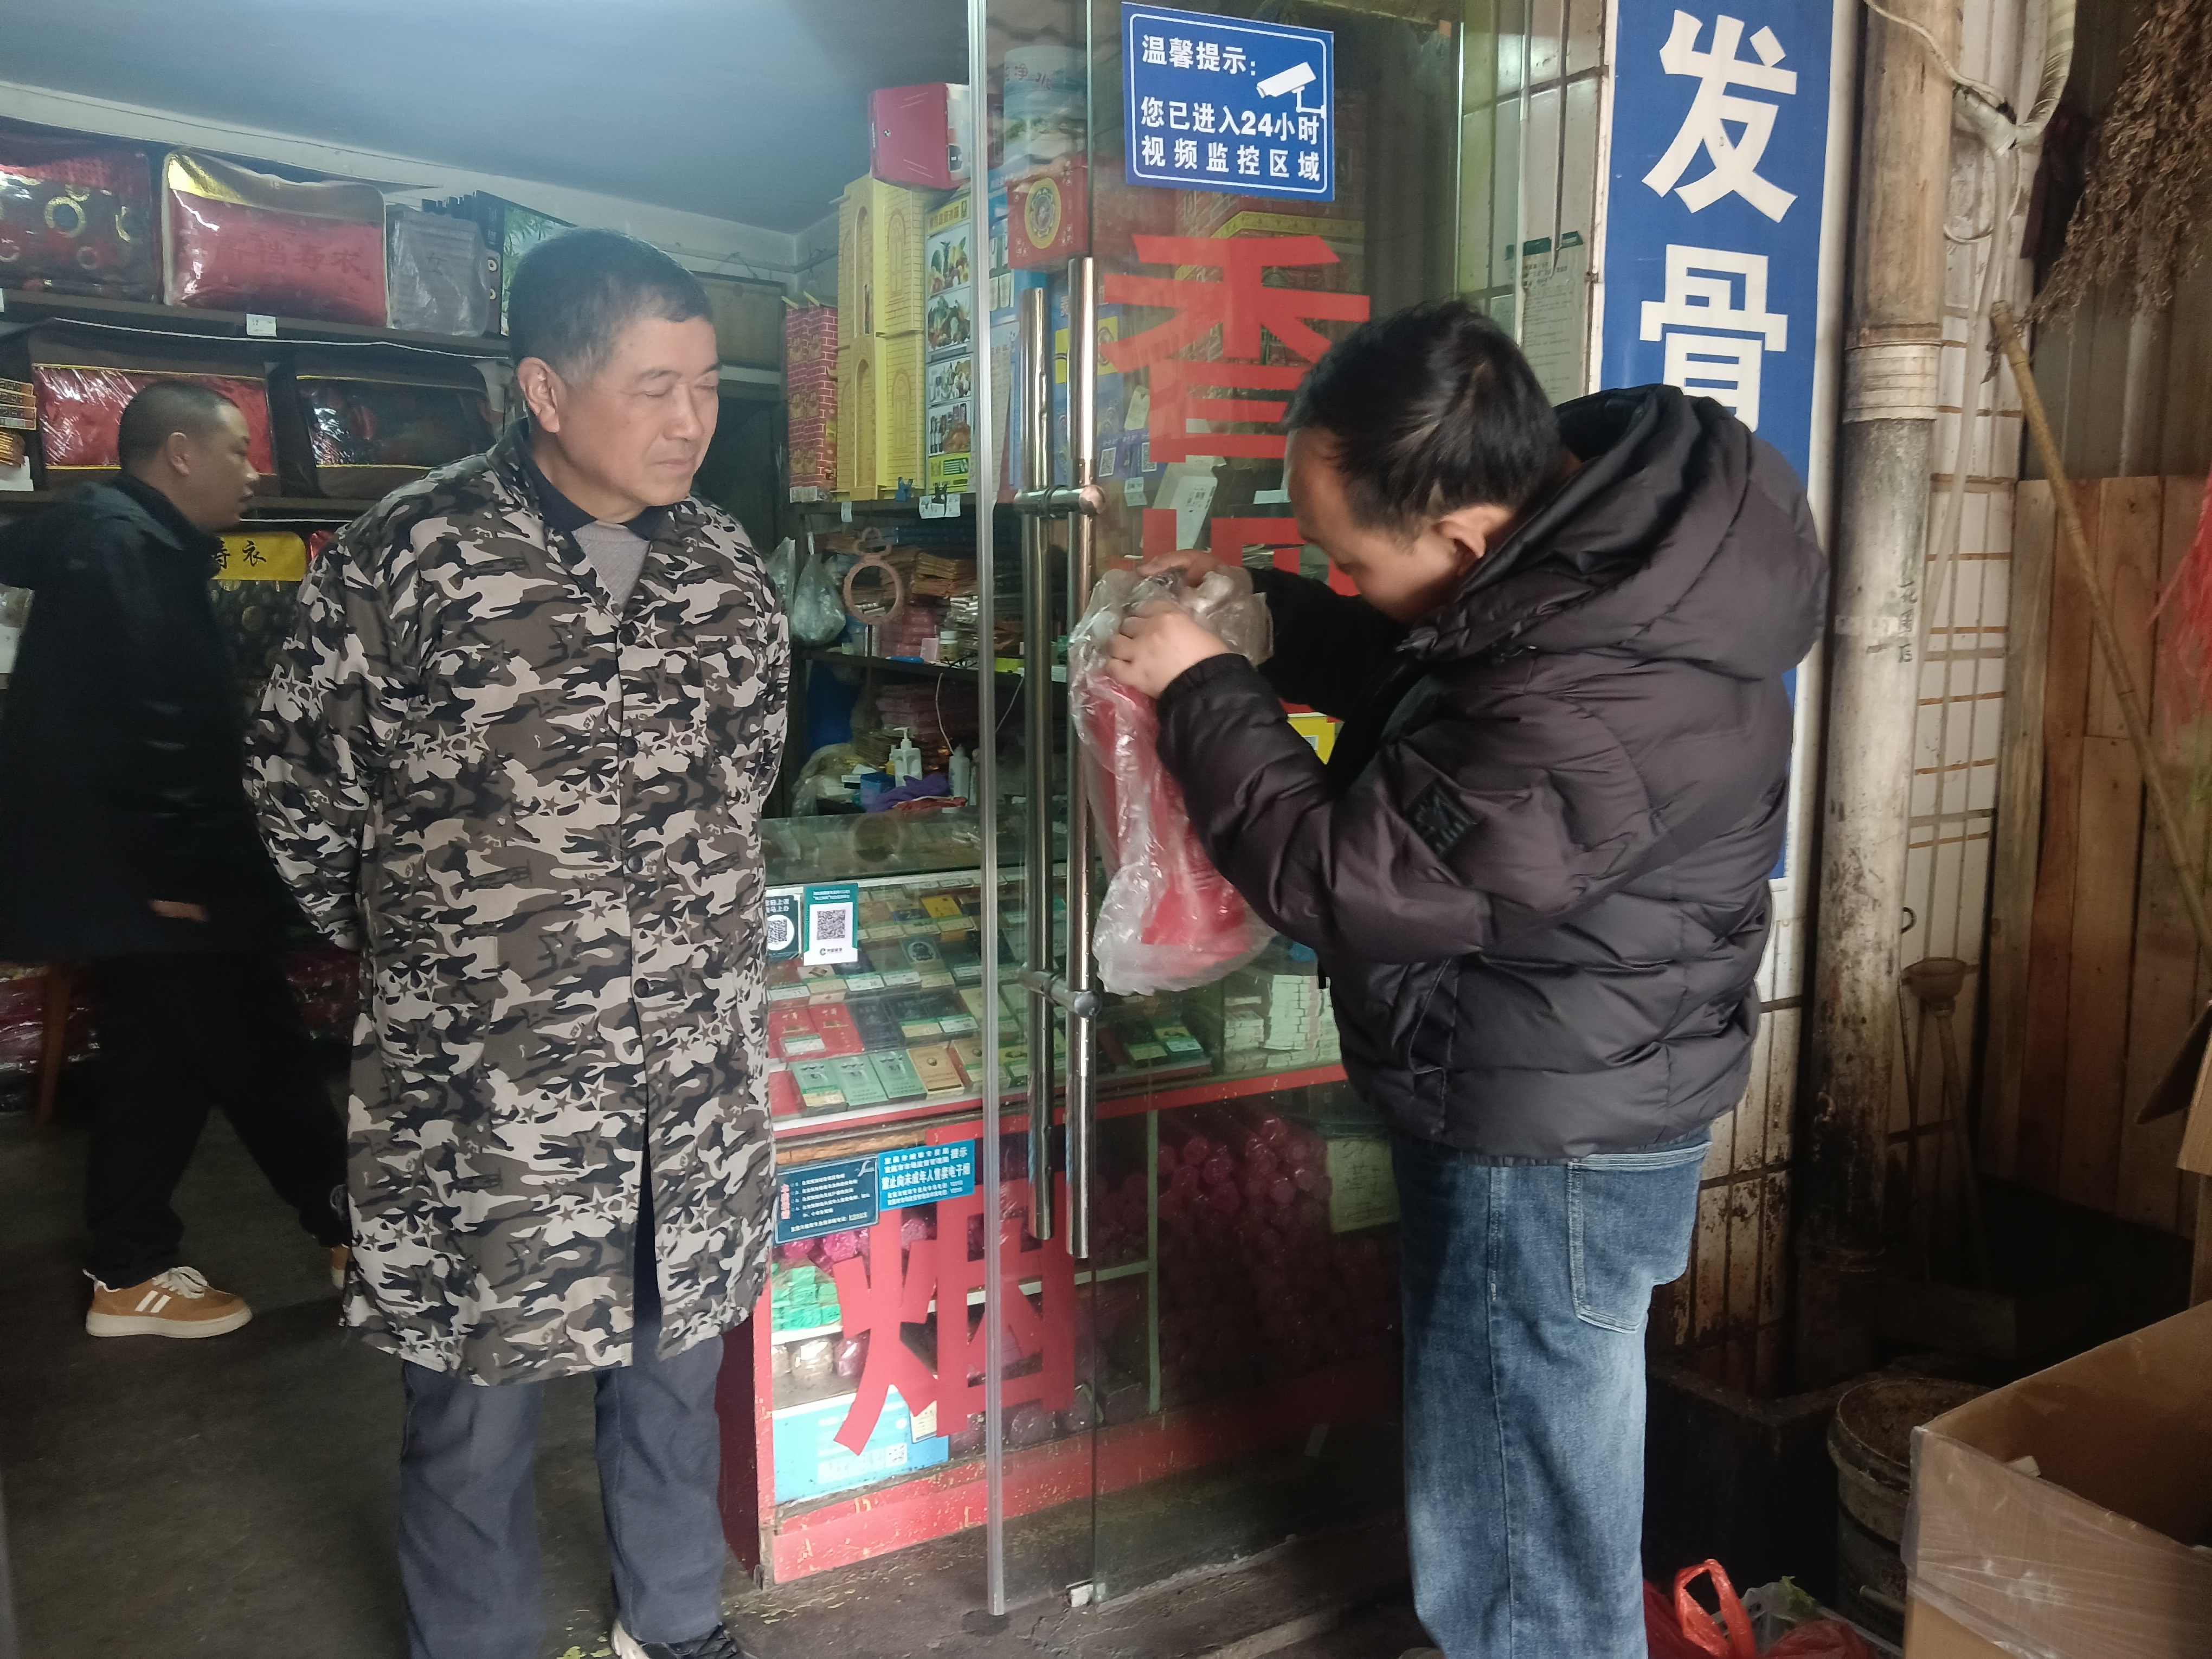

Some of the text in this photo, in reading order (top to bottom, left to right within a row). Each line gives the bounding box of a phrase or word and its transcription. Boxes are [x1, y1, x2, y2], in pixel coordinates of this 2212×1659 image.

[1142, 34, 1256, 76] 温馨提示：
[1140, 96, 1320, 145] 您已进入24小时
[1141, 135, 1321, 182] 视频监控区域
[833, 1171, 1075, 1456] 烟
